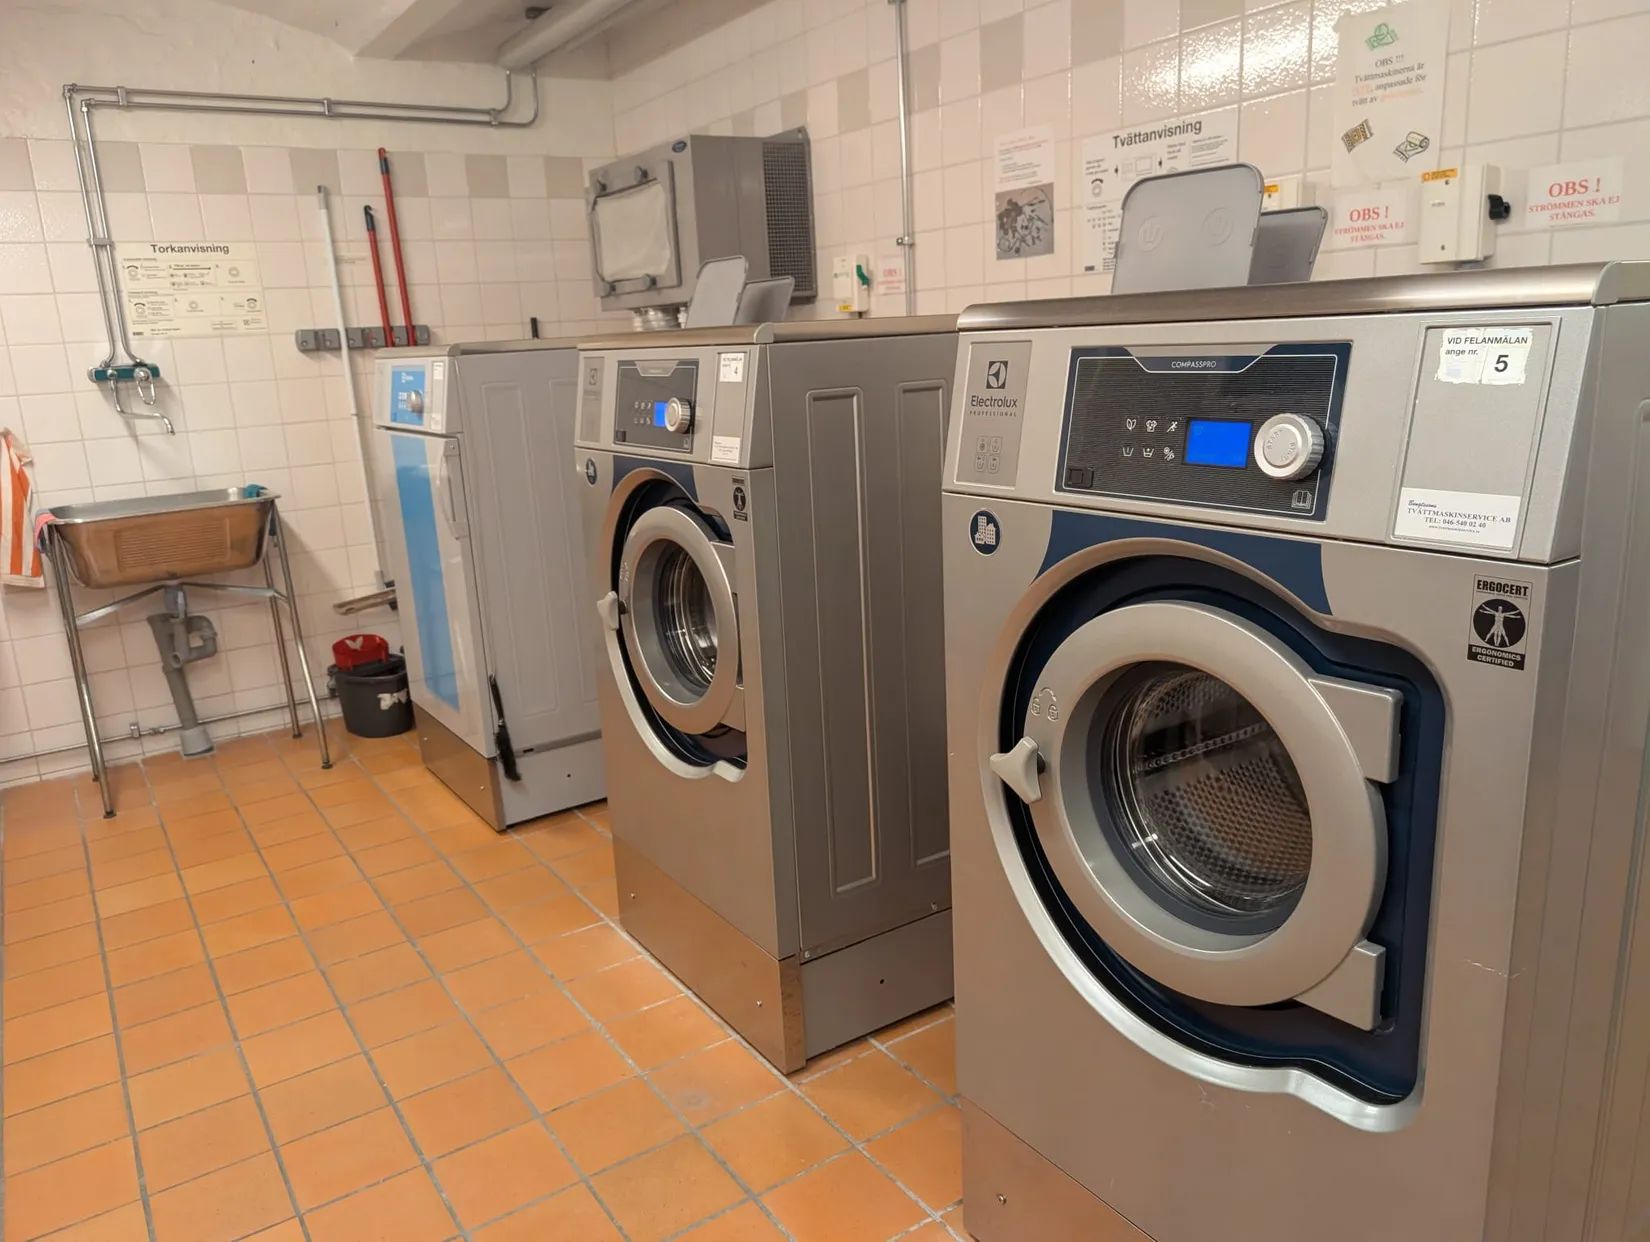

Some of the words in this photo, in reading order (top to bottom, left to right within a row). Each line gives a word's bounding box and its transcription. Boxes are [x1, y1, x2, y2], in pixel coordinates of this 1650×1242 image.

[1375, 57, 1393, 68] OBS
[1112, 120, 1203, 149] Tvättanvisning
[1548, 179, 1589, 198] OBS
[1595, 177, 1601, 193] !
[1528, 200, 1584, 213] STRÖMMEN
[1586, 197, 1606, 206] SKA
[1608, 195, 1620, 204] EJ
[1349, 207, 1380, 222] OBS
[1334, 224, 1377, 235] STRÖMMEN
[150, 243, 230, 255] Torkanvisning
[1447, 337, 1462, 345] VID
[1464, 335, 1528, 345] FELANMÄLAN
[1445, 349, 1466, 357] ange
[1171, 360, 1217, 368] COMPASSPRO
[1494, 354, 1509, 372] 5
[733, 366, 739, 376] 4
[971, 395, 1018, 408] Electrolux
[1407, 507, 1498, 522] TVÄTTMASKINSERVICE
[1442, 519, 1467, 527] 046-540
[1477, 580, 1529, 597] ERGOCERT
[1472, 646, 1521, 661] ERGONOMICS
[1477, 654, 1514, 667] CERTIFIED
